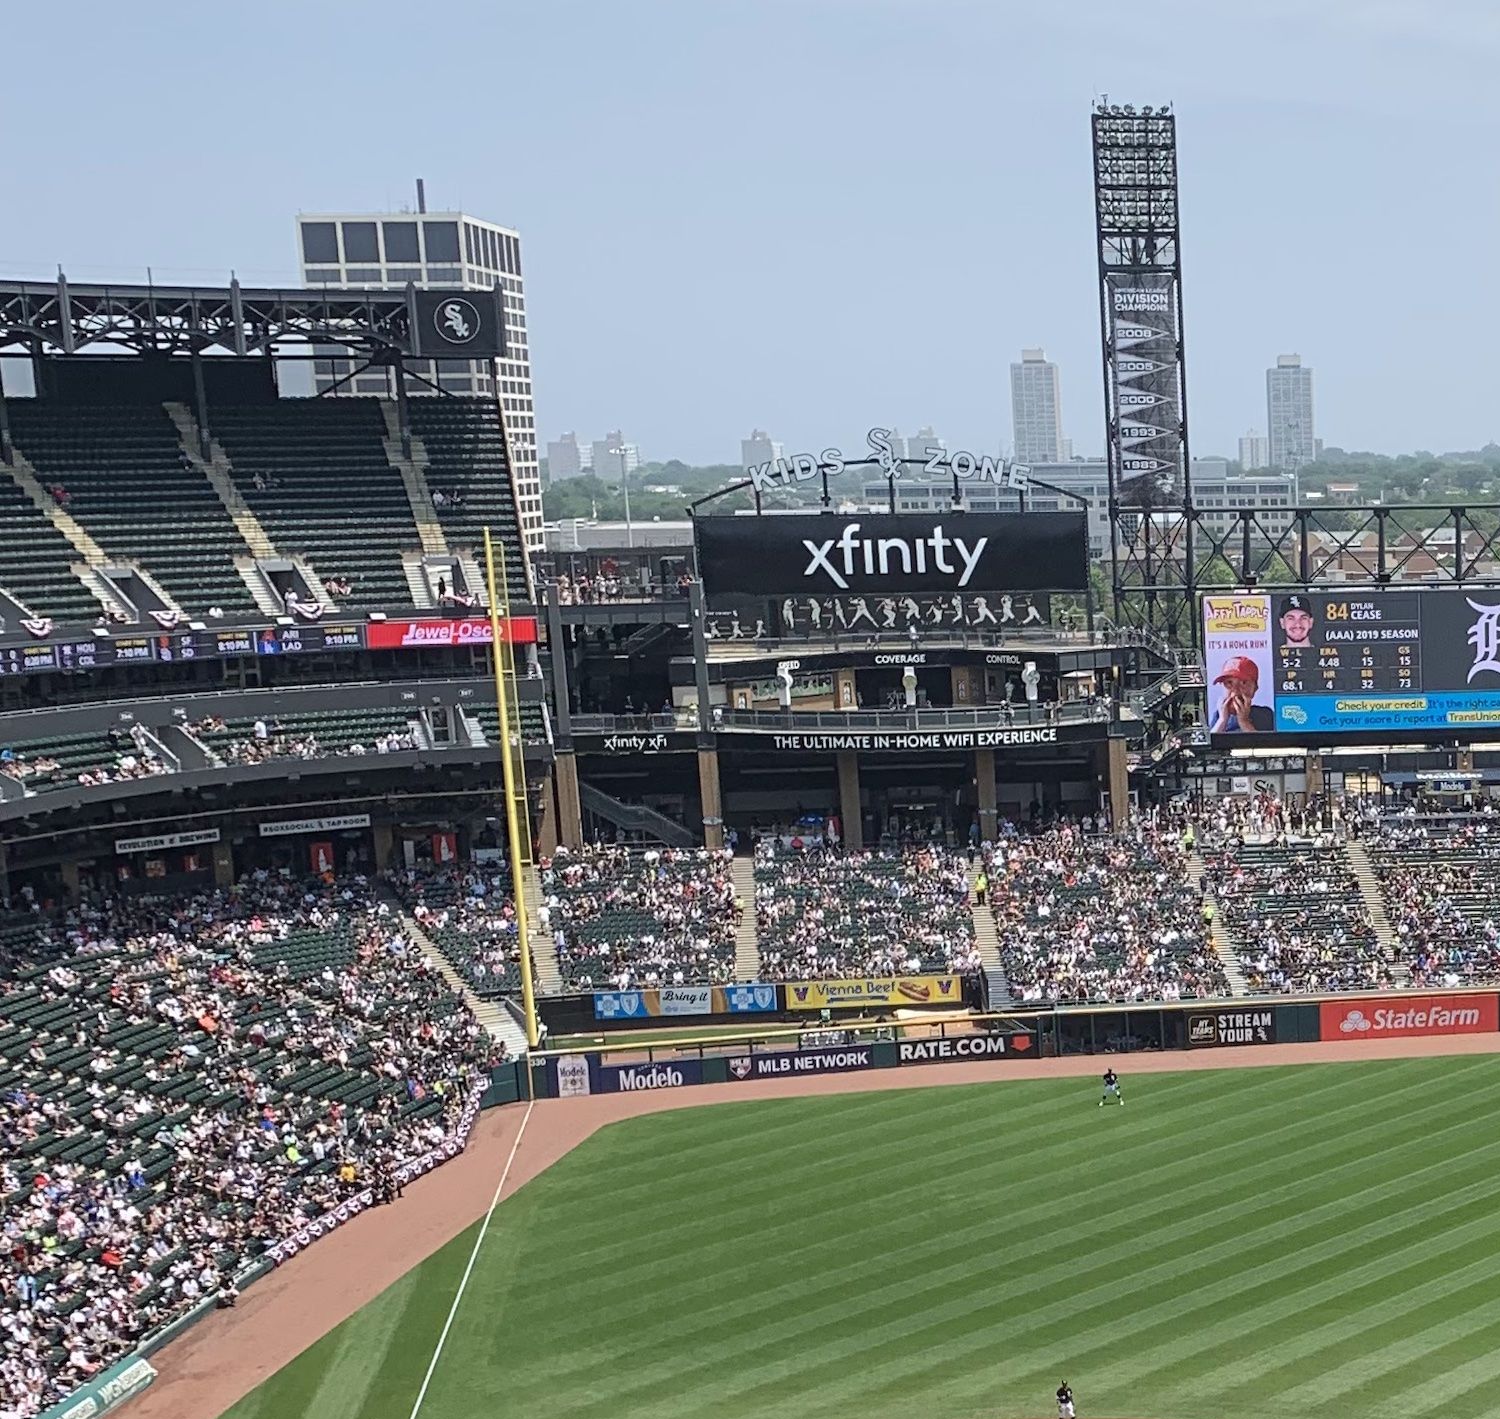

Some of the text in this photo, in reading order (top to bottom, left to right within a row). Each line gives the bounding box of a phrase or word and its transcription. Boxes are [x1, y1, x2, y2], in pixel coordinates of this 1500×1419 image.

[1115, 294, 1169, 304] DIVISION
[1115, 304, 1168, 312] CHAMPIONS
[1120, 396, 1155, 404] 2000
[748, 448, 1032, 491] KIDS ZONE
[802, 523, 988, 589] xfinity
[1326, 604, 1348, 620] 84
[1351, 610, 1381, 620] CEASE
[1326, 630, 1418, 640] (AAA) 2019 SEASON
[1209, 641, 1221, 649] IT'S
[1229, 641, 1247, 649] HOME
[875, 654, 925, 664] COVERAGE
[986, 654, 1020, 664] CONTROL
[1336, 701, 1367, 710] Check
[1369, 701, 1393, 711] your
[604, 735, 667, 750] xfinity xFi
[774, 728, 1057, 749] THE ULTIMATE IN-HOME WIFI EXPERIENCE
[663, 991, 697, 1002] Bring
[816, 982, 894, 997] Vienna Beef
[1218, 1013, 1271, 1027] STREAM
[1218, 1028, 1253, 1042] YOUR
[901, 1037, 1005, 1060] RATE.COM
[758, 1052, 868, 1073] MLB NETWORK
[619, 1067, 683, 1091] Modelo
